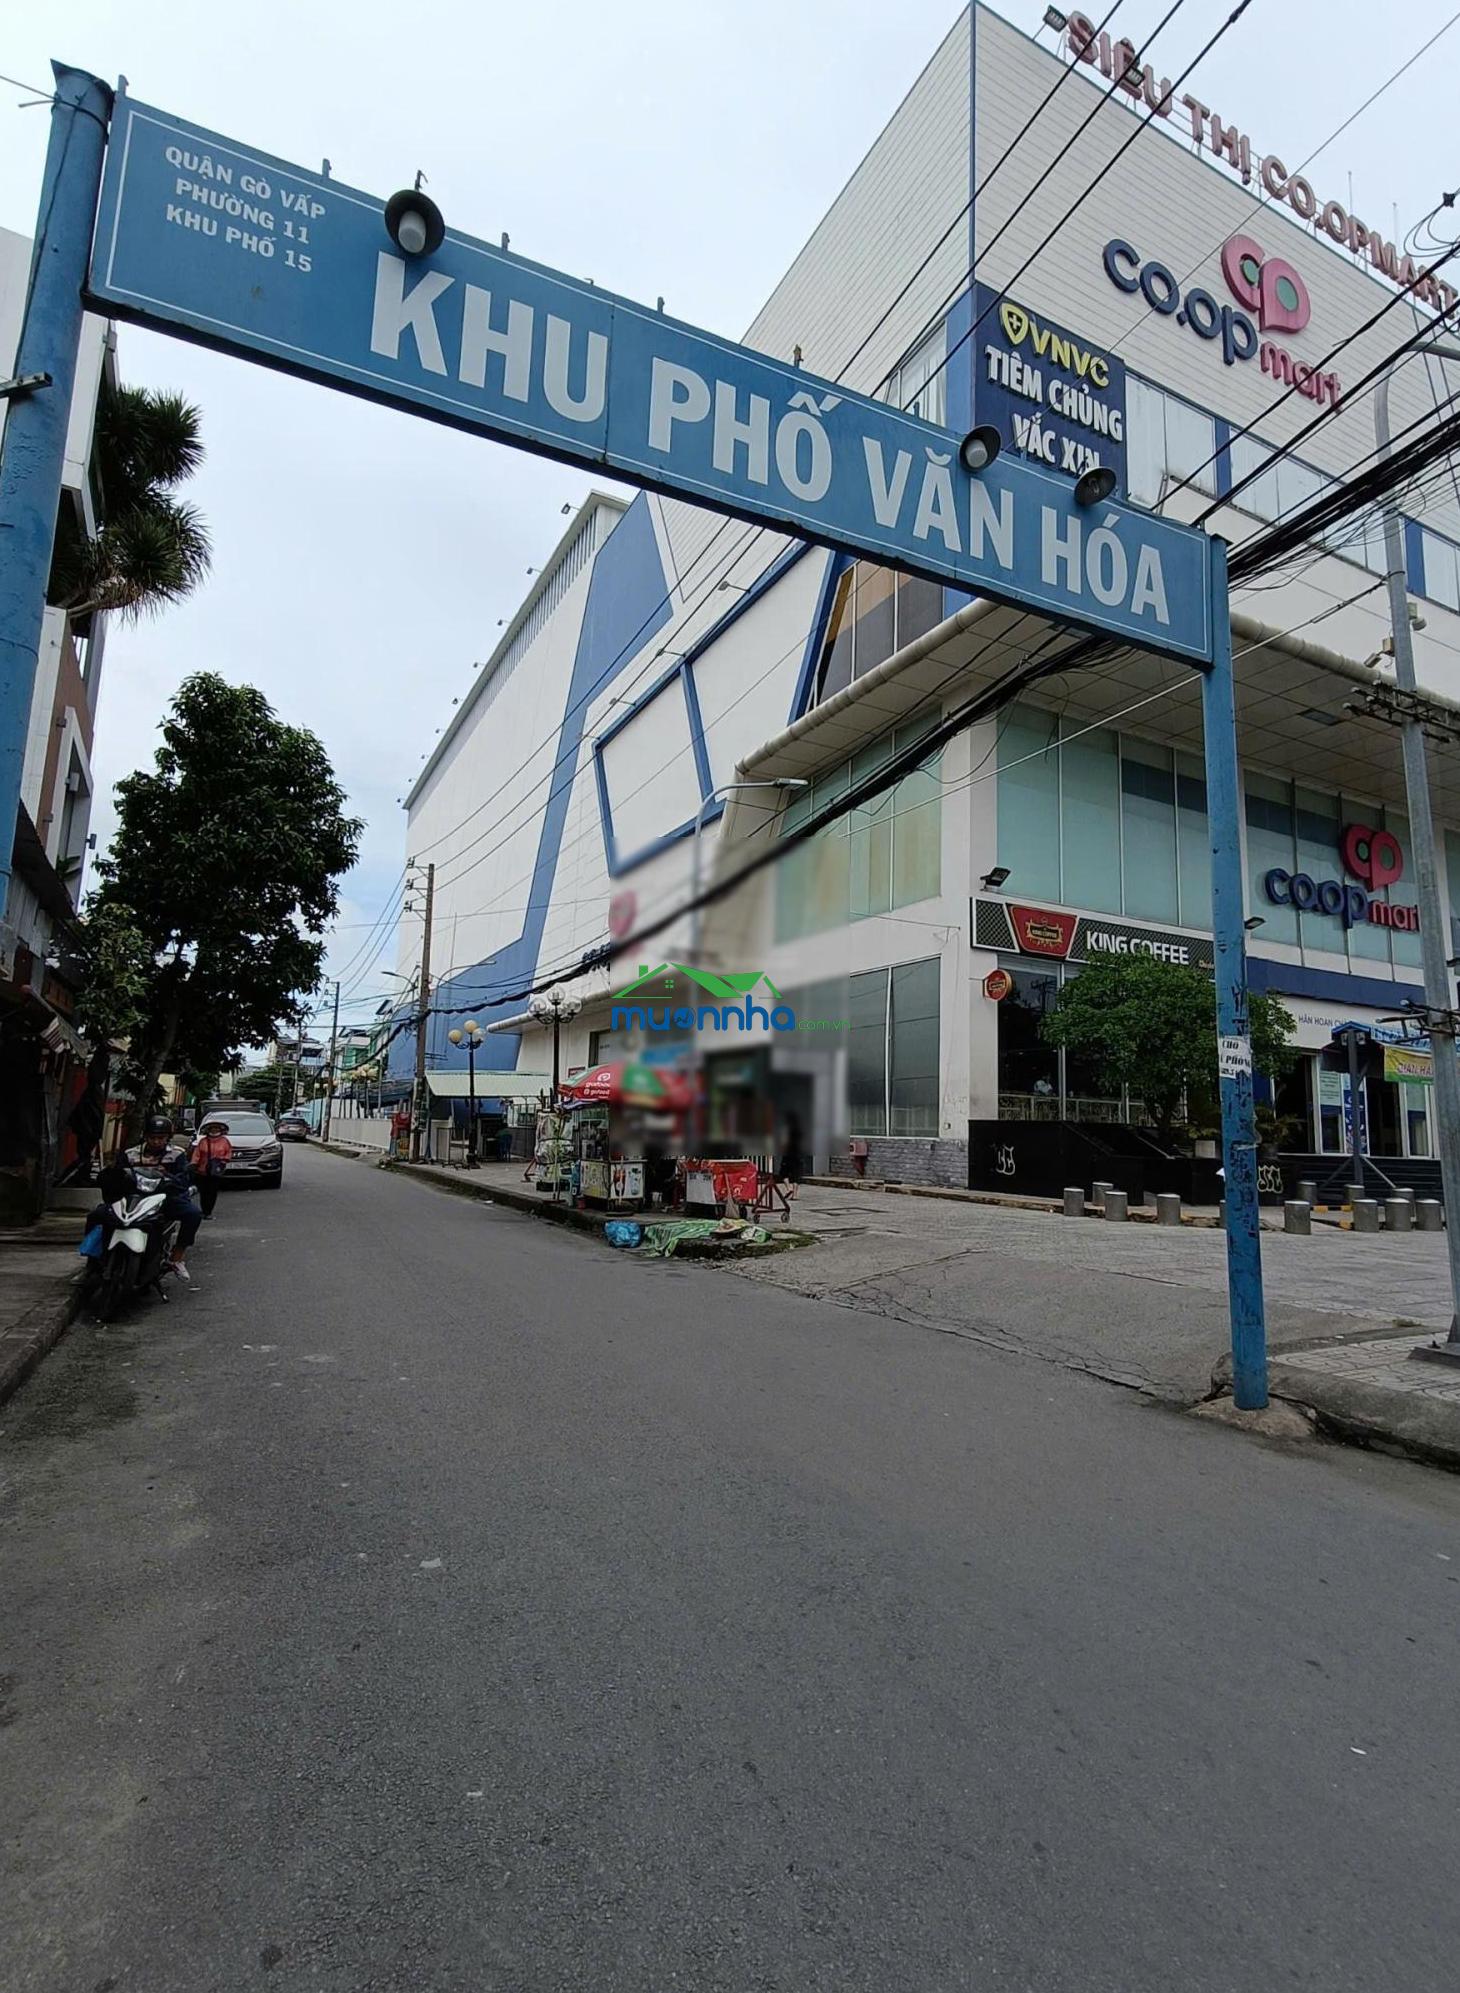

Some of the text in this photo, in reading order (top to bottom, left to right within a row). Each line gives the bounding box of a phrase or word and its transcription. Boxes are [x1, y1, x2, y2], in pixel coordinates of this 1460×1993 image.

[165, 146, 326, 219] QUẬN GÒ VẤP
[1068, 11, 1458, 320] SIÊU THỊ CO.OPMART
[166, 204, 312, 272] KHU PHỐ 15
[176, 178, 310, 244] PHƯỜNG 11
[1030, 320, 1110, 387] VNVC
[984, 345, 1123, 442] TIÊM CHỦNG
[370, 250, 1171, 626] KHU PHỐ VĂN HÓA
[1012, 411, 1100, 476] VẮC XIN
[1086, 930, 1190, 965] KING COFFEE
